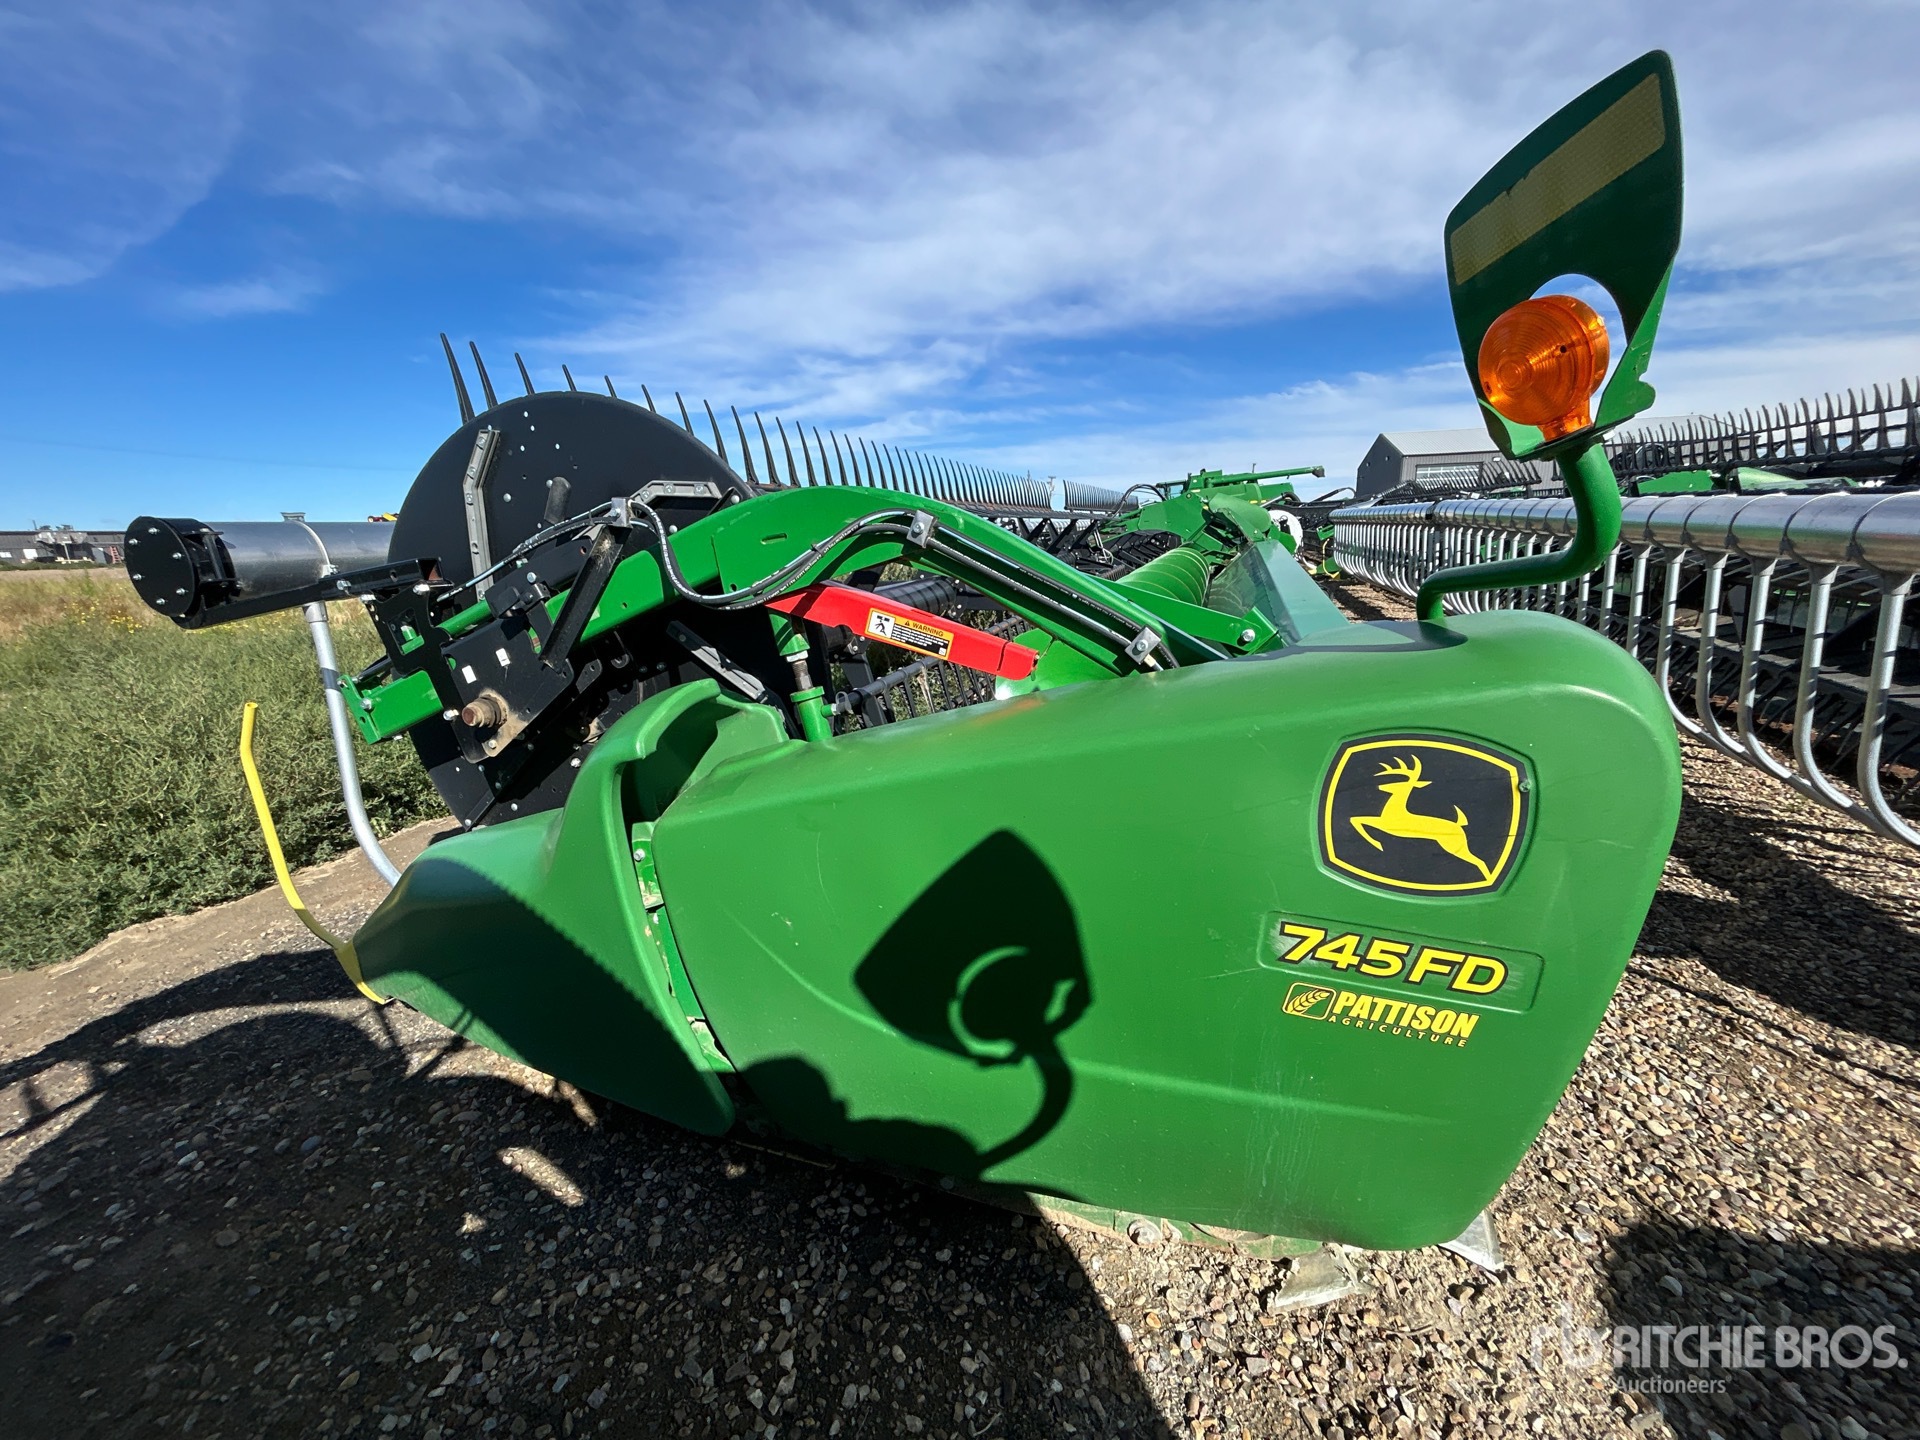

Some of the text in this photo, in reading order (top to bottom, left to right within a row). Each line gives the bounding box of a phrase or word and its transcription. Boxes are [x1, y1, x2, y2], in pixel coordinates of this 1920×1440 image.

[912, 622, 944, 637] WARNING
[1280, 922, 1508, 995] 745FD
[1328, 1015, 1469, 1047] AGRICULTURE
[1333, 990, 1479, 1038] PATTISON
